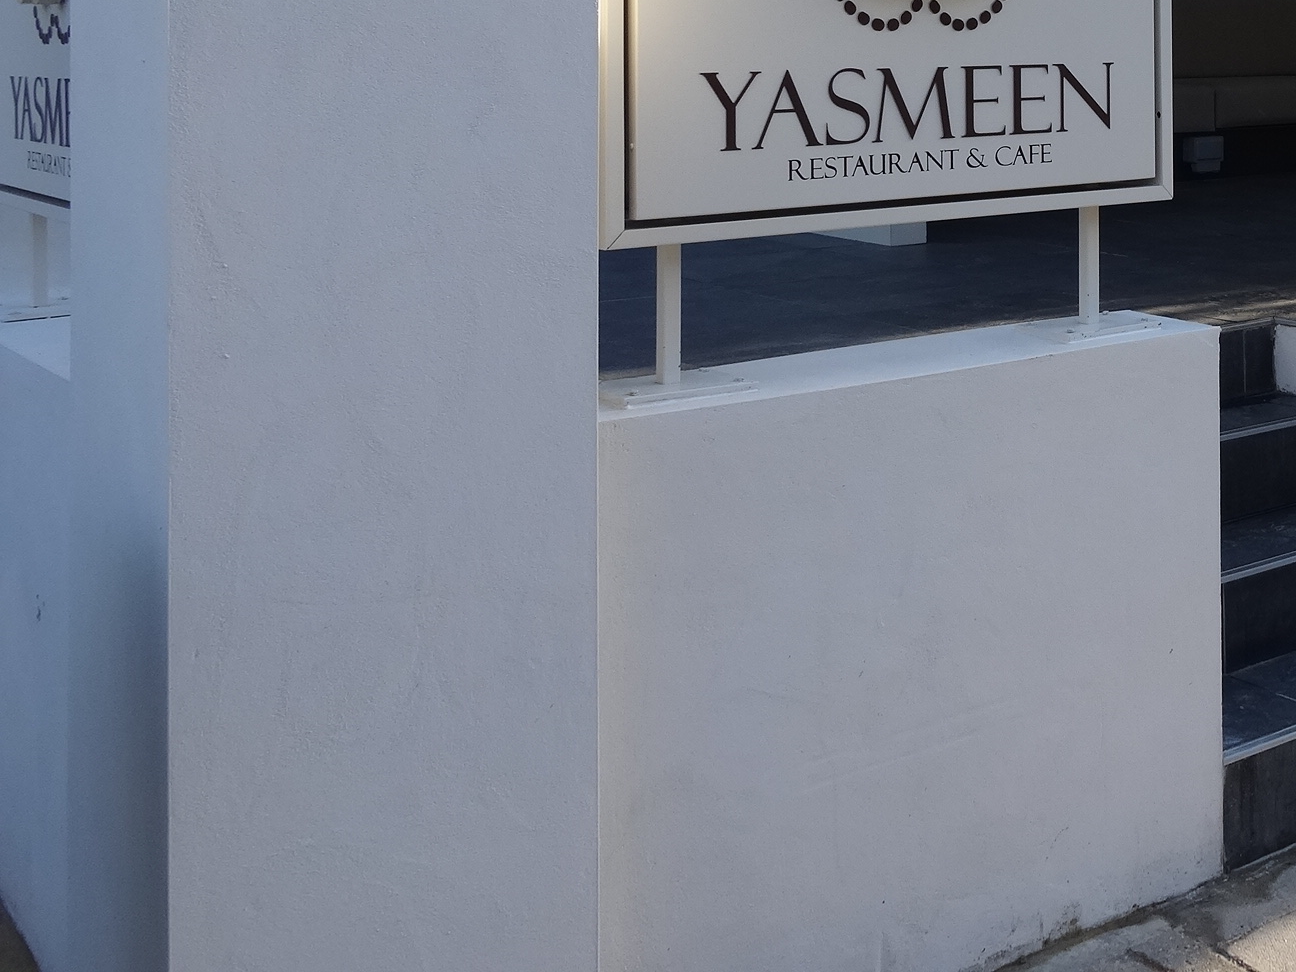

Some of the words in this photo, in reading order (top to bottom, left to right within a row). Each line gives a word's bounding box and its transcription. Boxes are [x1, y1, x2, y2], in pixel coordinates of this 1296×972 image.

[699, 61, 1115, 152] YASMEEN
[787, 148, 960, 182] RESTAURANT
[966, 147, 988, 169] &
[995, 143, 1053, 167] CAFE
